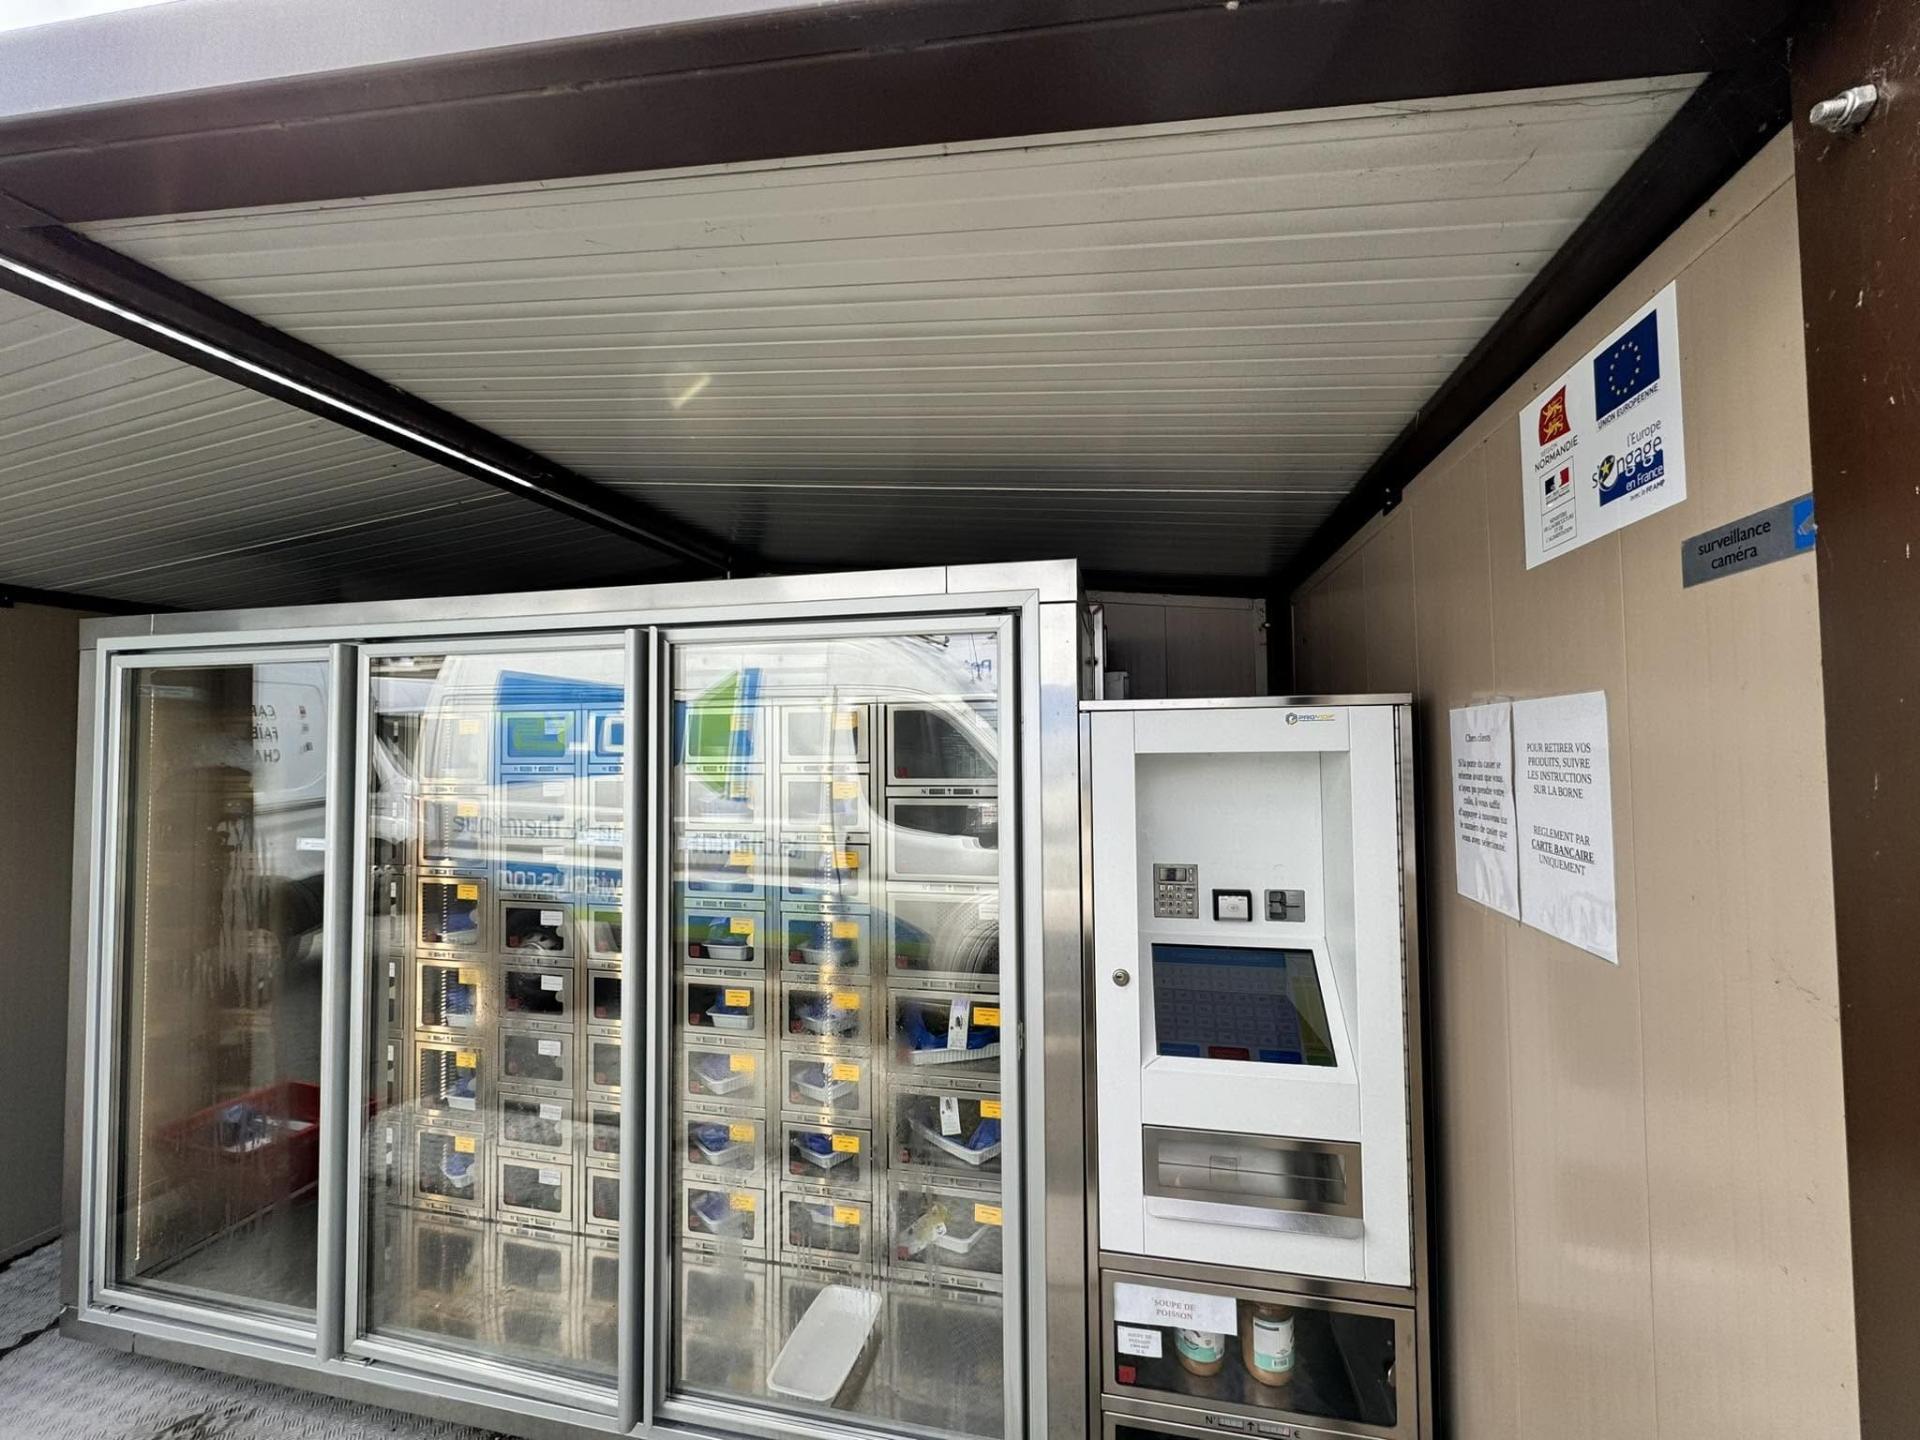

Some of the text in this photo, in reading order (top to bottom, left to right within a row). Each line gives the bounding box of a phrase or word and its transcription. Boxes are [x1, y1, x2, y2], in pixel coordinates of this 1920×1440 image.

[1598, 411, 1616, 430] UNION
[1626, 420, 1662, 448] l'Europe
[1534, 435, 1578, 473] NORMANDIE
[1626, 464, 1663, 492] en France
[1698, 521, 1772, 556] surveillance
[1711, 546, 1758, 569] caméra
[1526, 742, 1592, 754] POUR RETIRER VOS
[1528, 757, 1590, 769] PRODUITS, SUIVRE
[1528, 770, 1592, 784] LES INSTRUCTIONS
[1533, 784, 1584, 798] SUR LA BORNE
[1533, 825, 1590, 846] REGLEMENT PAR
[1532, 839, 1594, 863] CARTE BANCAIRE
[1538, 854, 1586, 876] UNIQUEMENT
[1154, 1299, 1194, 1311] SOUPE DE
[1156, 1309, 1193, 1320] POISSON
